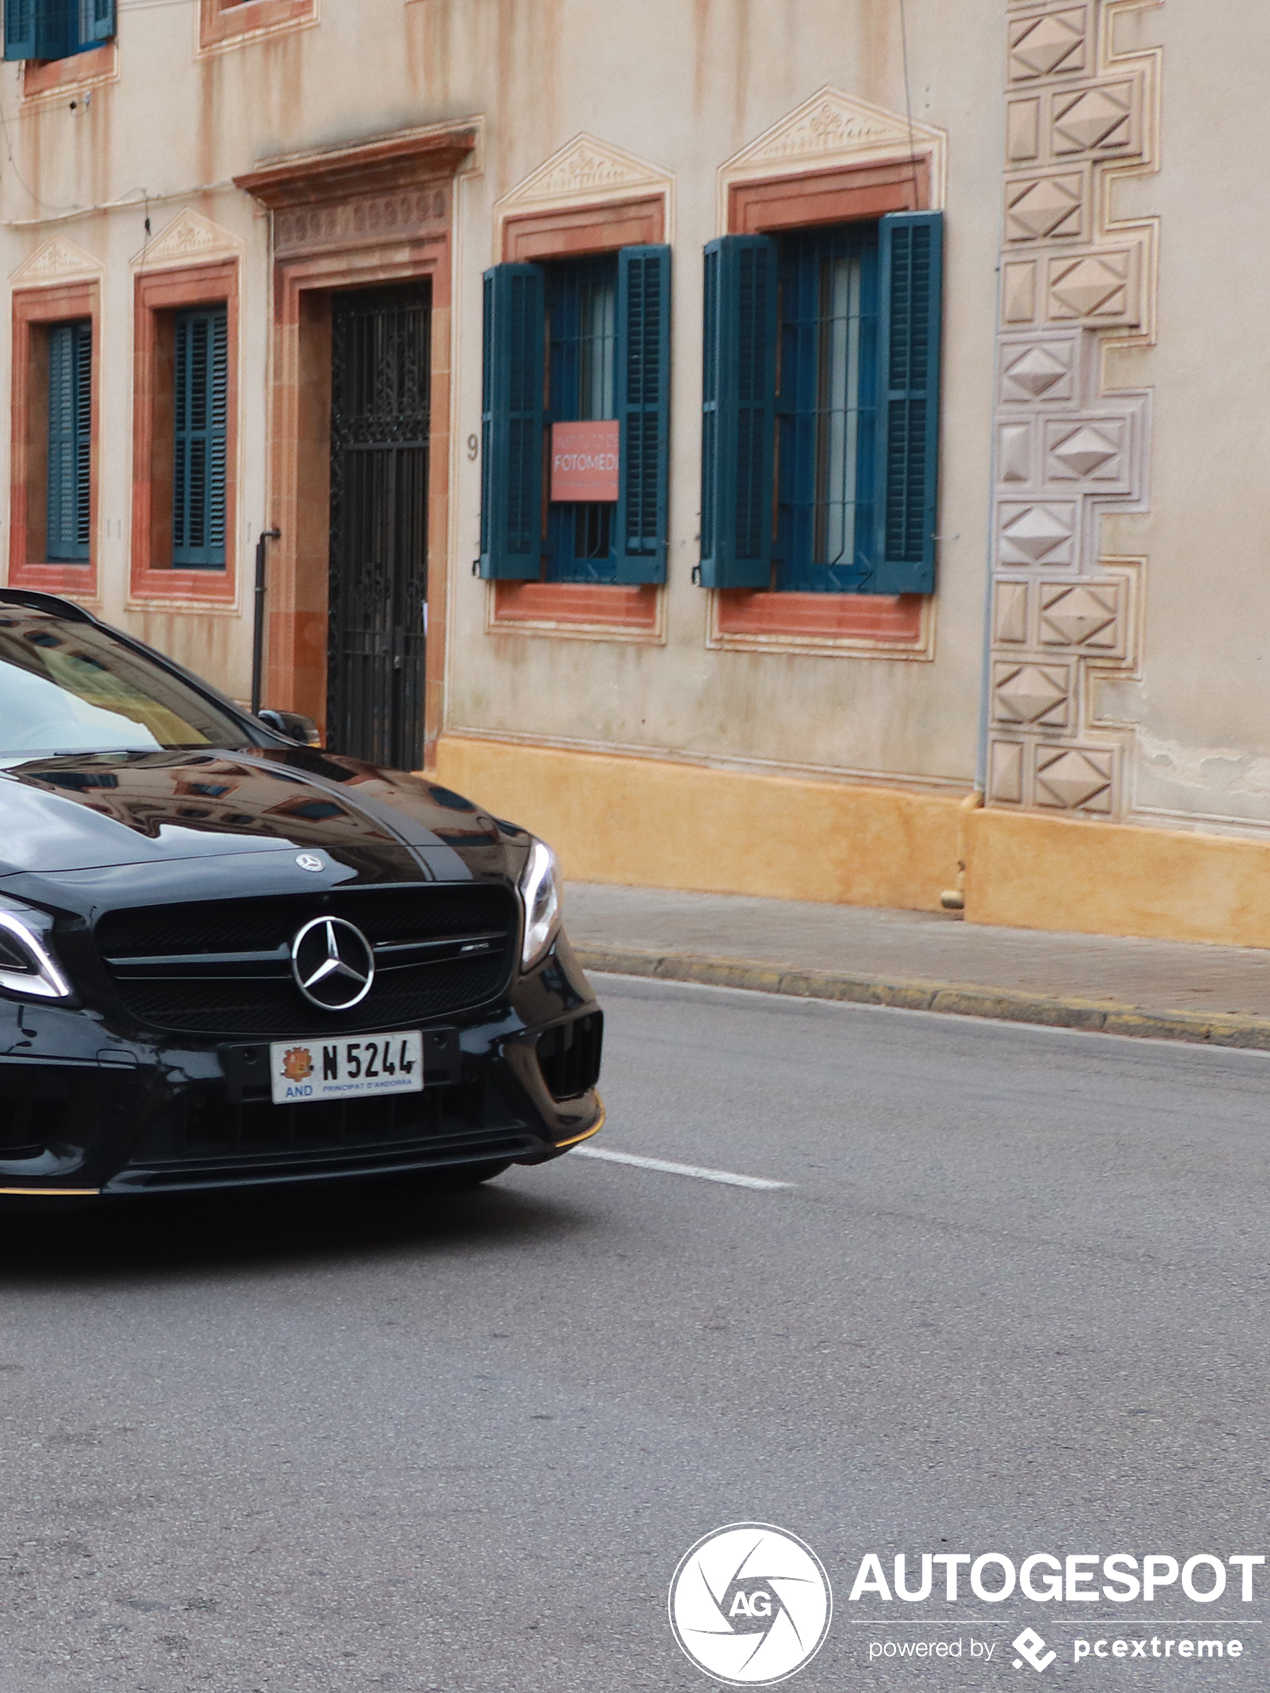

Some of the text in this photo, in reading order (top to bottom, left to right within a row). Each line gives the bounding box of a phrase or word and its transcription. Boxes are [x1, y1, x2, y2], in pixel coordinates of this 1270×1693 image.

[467, 433, 479, 461] 9
[322, 1039, 416, 1081] N 5244
[285, 1085, 313, 1098] AND
[322, 1079, 412, 1092] PRINCIPAT D'ANDORRA
